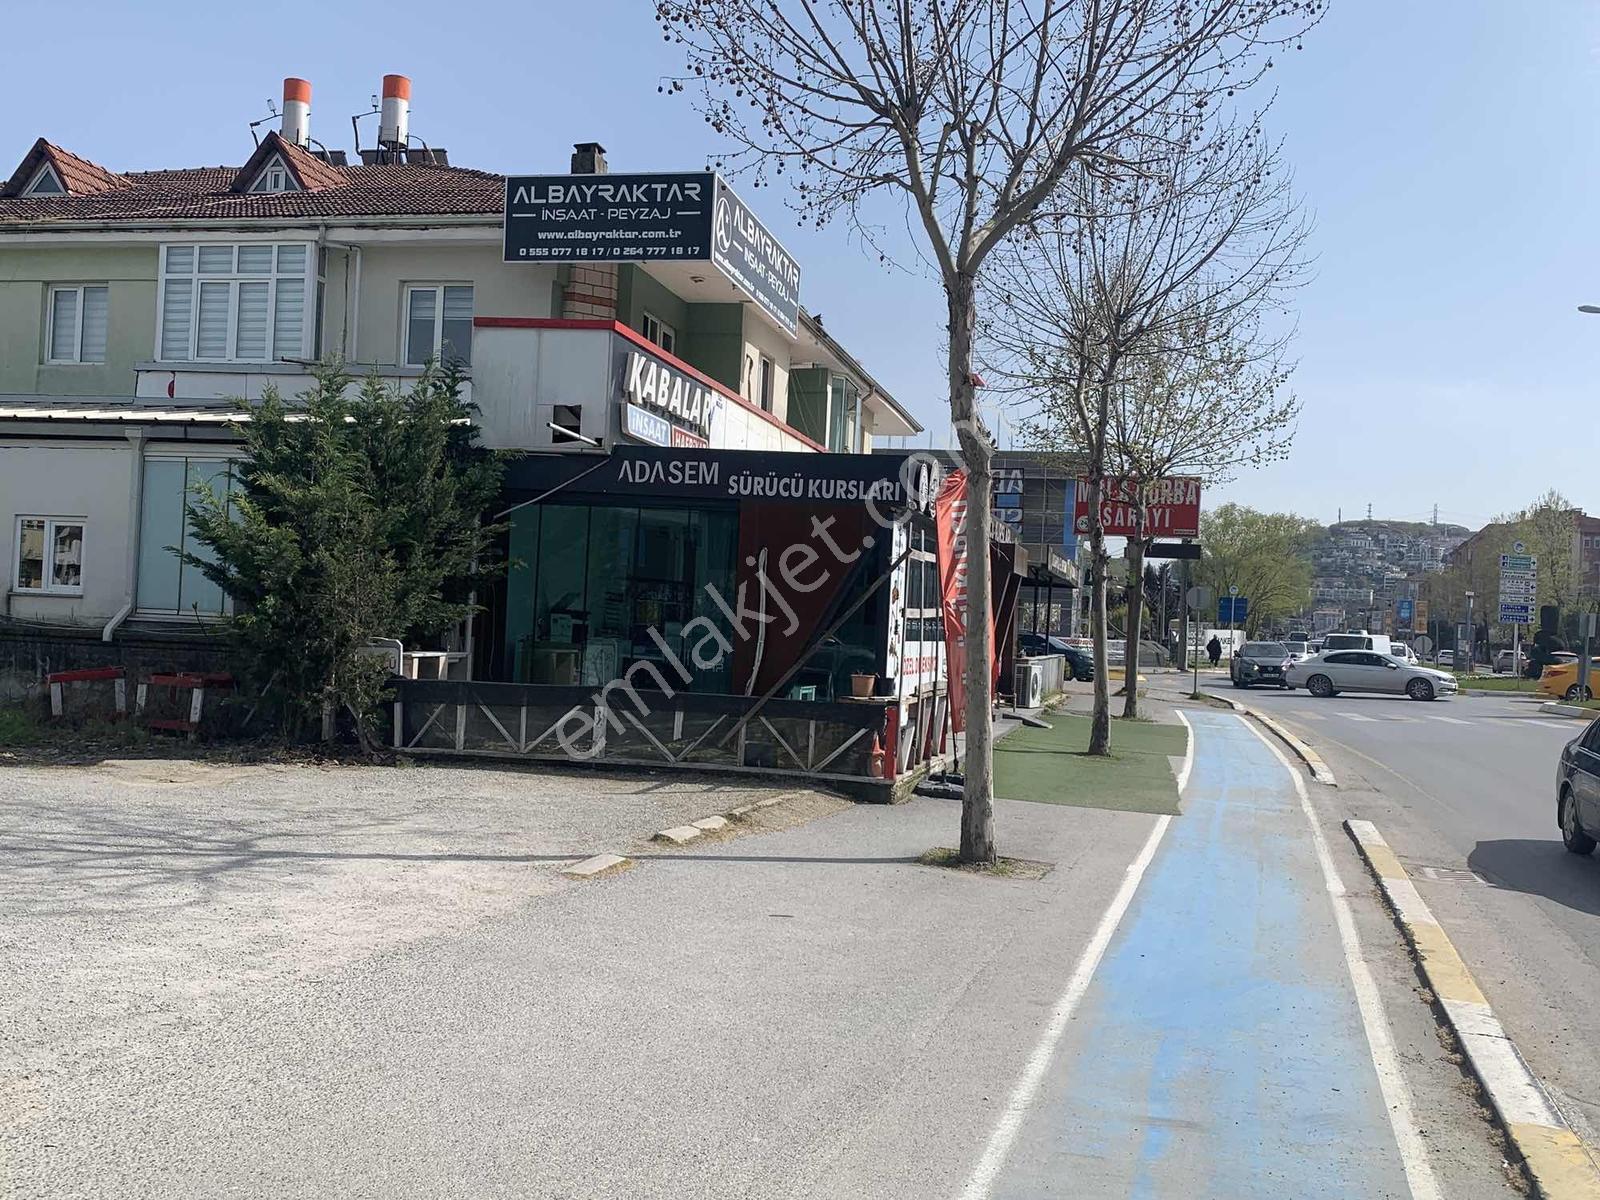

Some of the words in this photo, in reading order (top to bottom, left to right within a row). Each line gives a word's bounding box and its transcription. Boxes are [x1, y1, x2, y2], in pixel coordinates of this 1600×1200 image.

[513, 183, 702, 204] ALBAYRAKTAR
[541, 206, 598, 223] İNŞAAT
[607, 207, 671, 220] PEYZAJ
[537, 228, 682, 242] www.albayraktar.com.tr
[551, 247, 572, 256] 077
[646, 246, 667, 255] 777
[687, 246, 700, 255] 17
[733, 204, 799, 292] ALBAYRAKTAR
[627, 351, 712, 436] KABALAR
[617, 459, 719, 485] ADASEM
[727, 470, 804, 498] SÜRÜCÜ
[807, 478, 901, 501] KURSLARI
